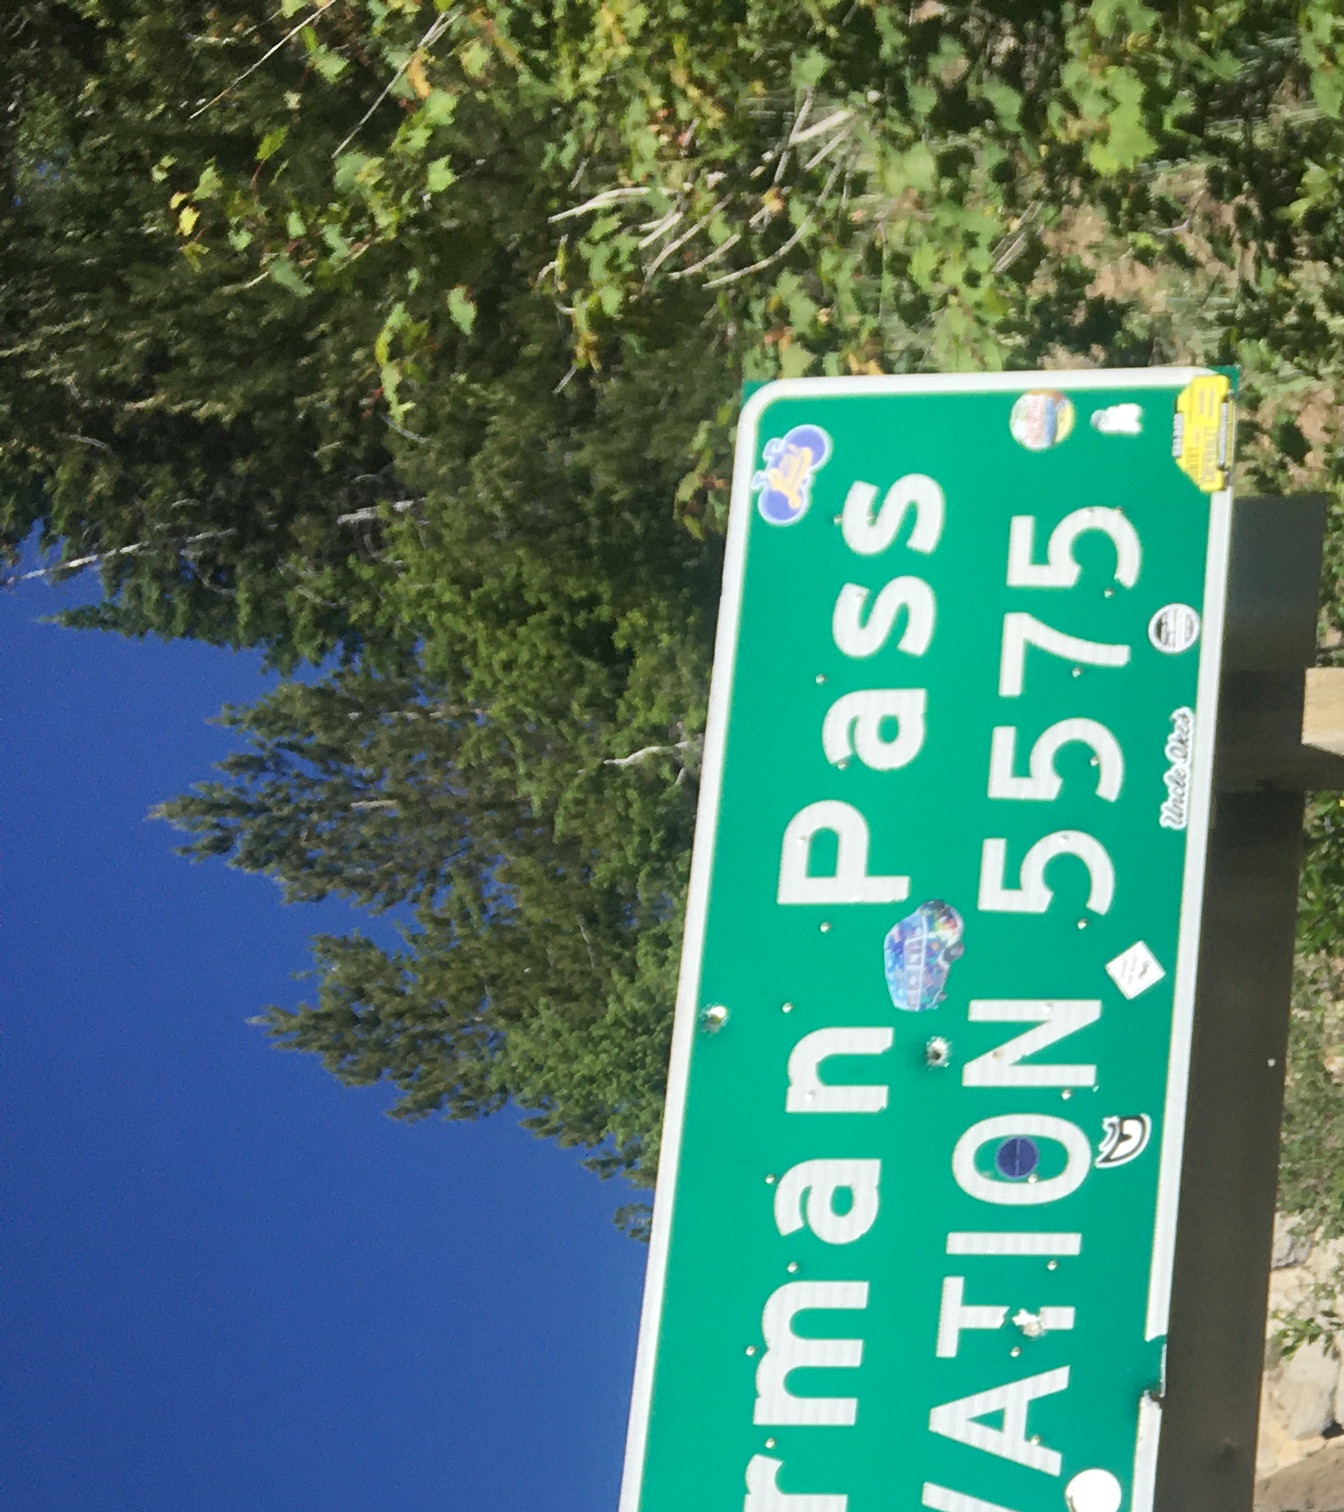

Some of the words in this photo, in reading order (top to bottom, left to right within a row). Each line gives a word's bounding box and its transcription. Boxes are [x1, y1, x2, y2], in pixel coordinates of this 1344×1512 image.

[778, 474, 945, 905] Pass
[978, 507, 1140, 915] 5575
[1163, 768, 1188, 826] Uncle
